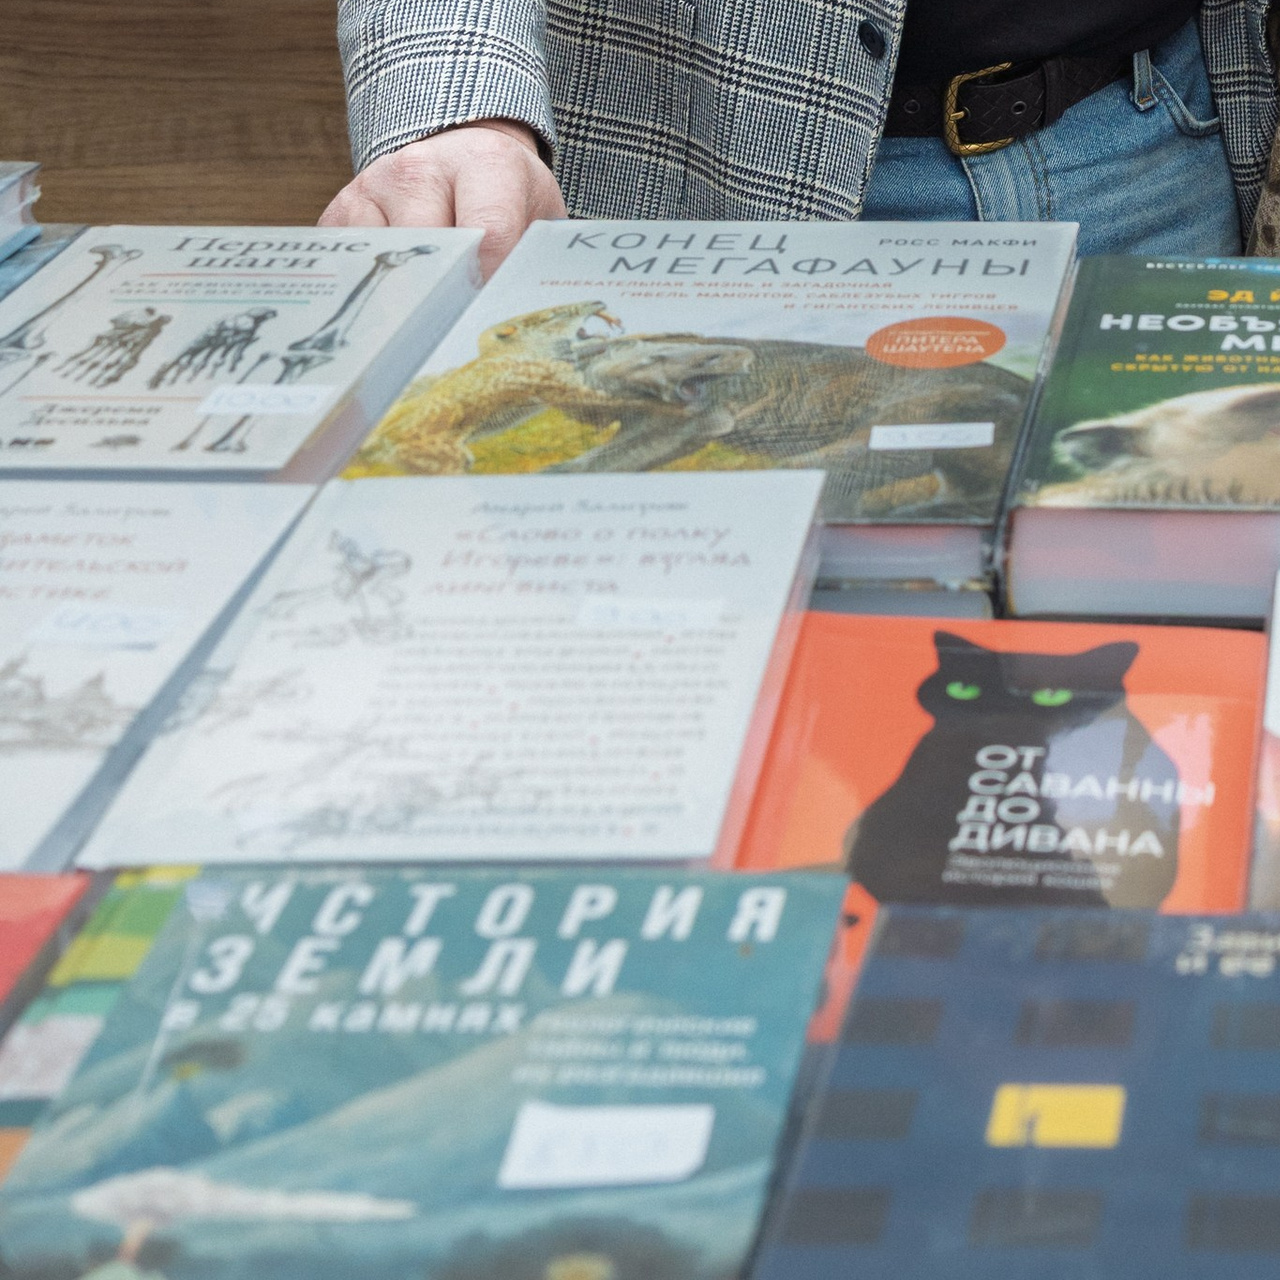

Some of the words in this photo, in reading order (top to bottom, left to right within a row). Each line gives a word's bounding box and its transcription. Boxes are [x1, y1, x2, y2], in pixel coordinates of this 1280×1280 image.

[168, 237, 372, 256] Первые
[566, 232, 789, 254] КОНЕЦ
[878, 237, 940, 247] РОСС
[951, 237, 1038, 248] МАКФИ
[184, 257, 321, 269] шаги
[607, 255, 1031, 277] МЕГАФАУНЫ
[1206, 289, 1255, 303] ЭД
[975, 744, 1047, 771] ОТ
[967, 770, 1217, 808] САВАННЫ
[955, 795, 1042, 824] ДО
[947, 822, 1165, 859] ДИВАНА
[187, 934, 629, 996] ЗЕМЛИ
[218, 992, 292, 1033] 25
[307, 1001, 525, 1033] камнях
